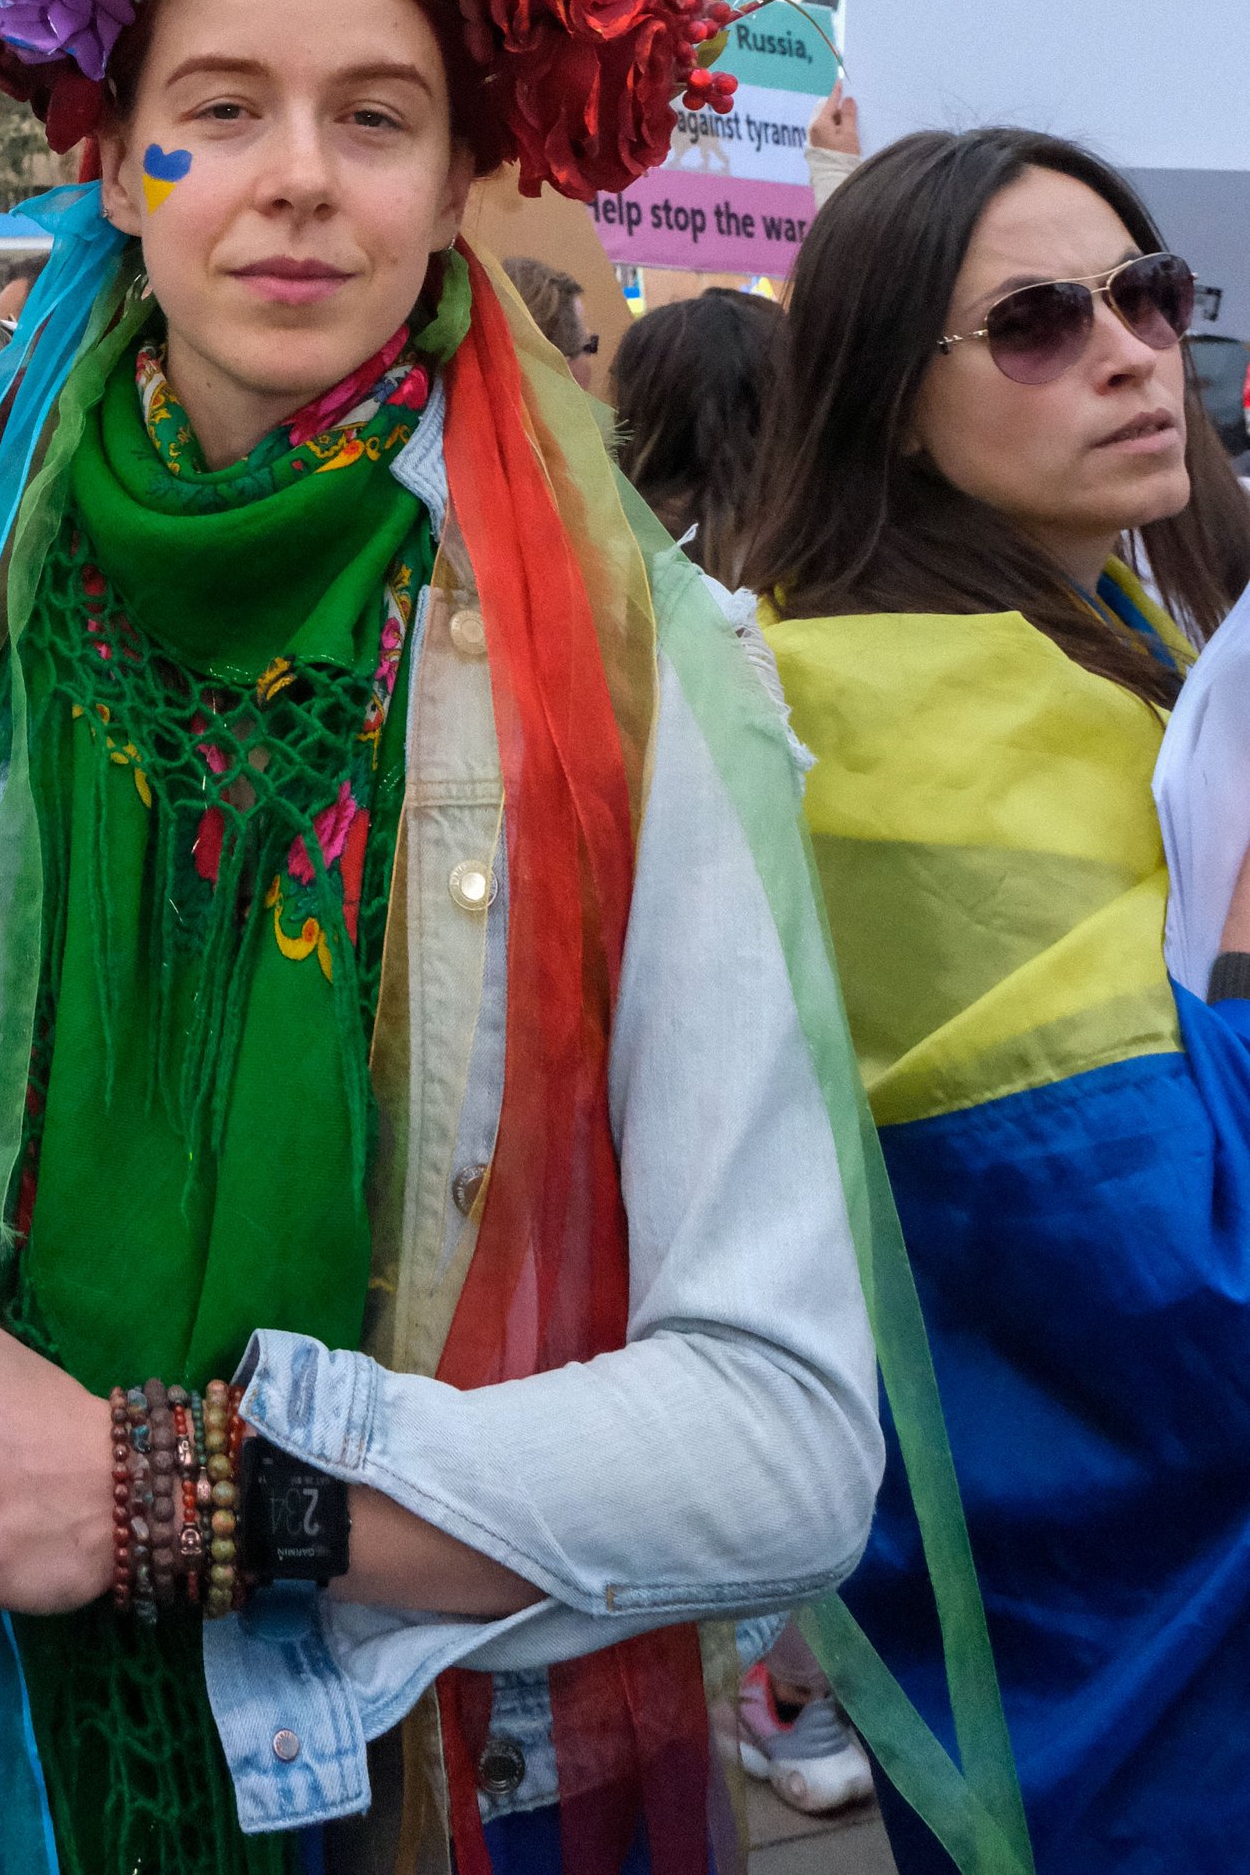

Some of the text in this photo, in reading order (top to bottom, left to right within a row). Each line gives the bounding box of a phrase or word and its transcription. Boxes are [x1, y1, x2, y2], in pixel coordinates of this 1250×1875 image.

[735, 24, 813, 64] Russia,
[677, 108, 743, 145] against
[651, 198, 706, 244] stop
[713, 200, 756, 239] the
[761, 215, 807, 243] war
[276, 1546, 316, 1561] GARMIN
